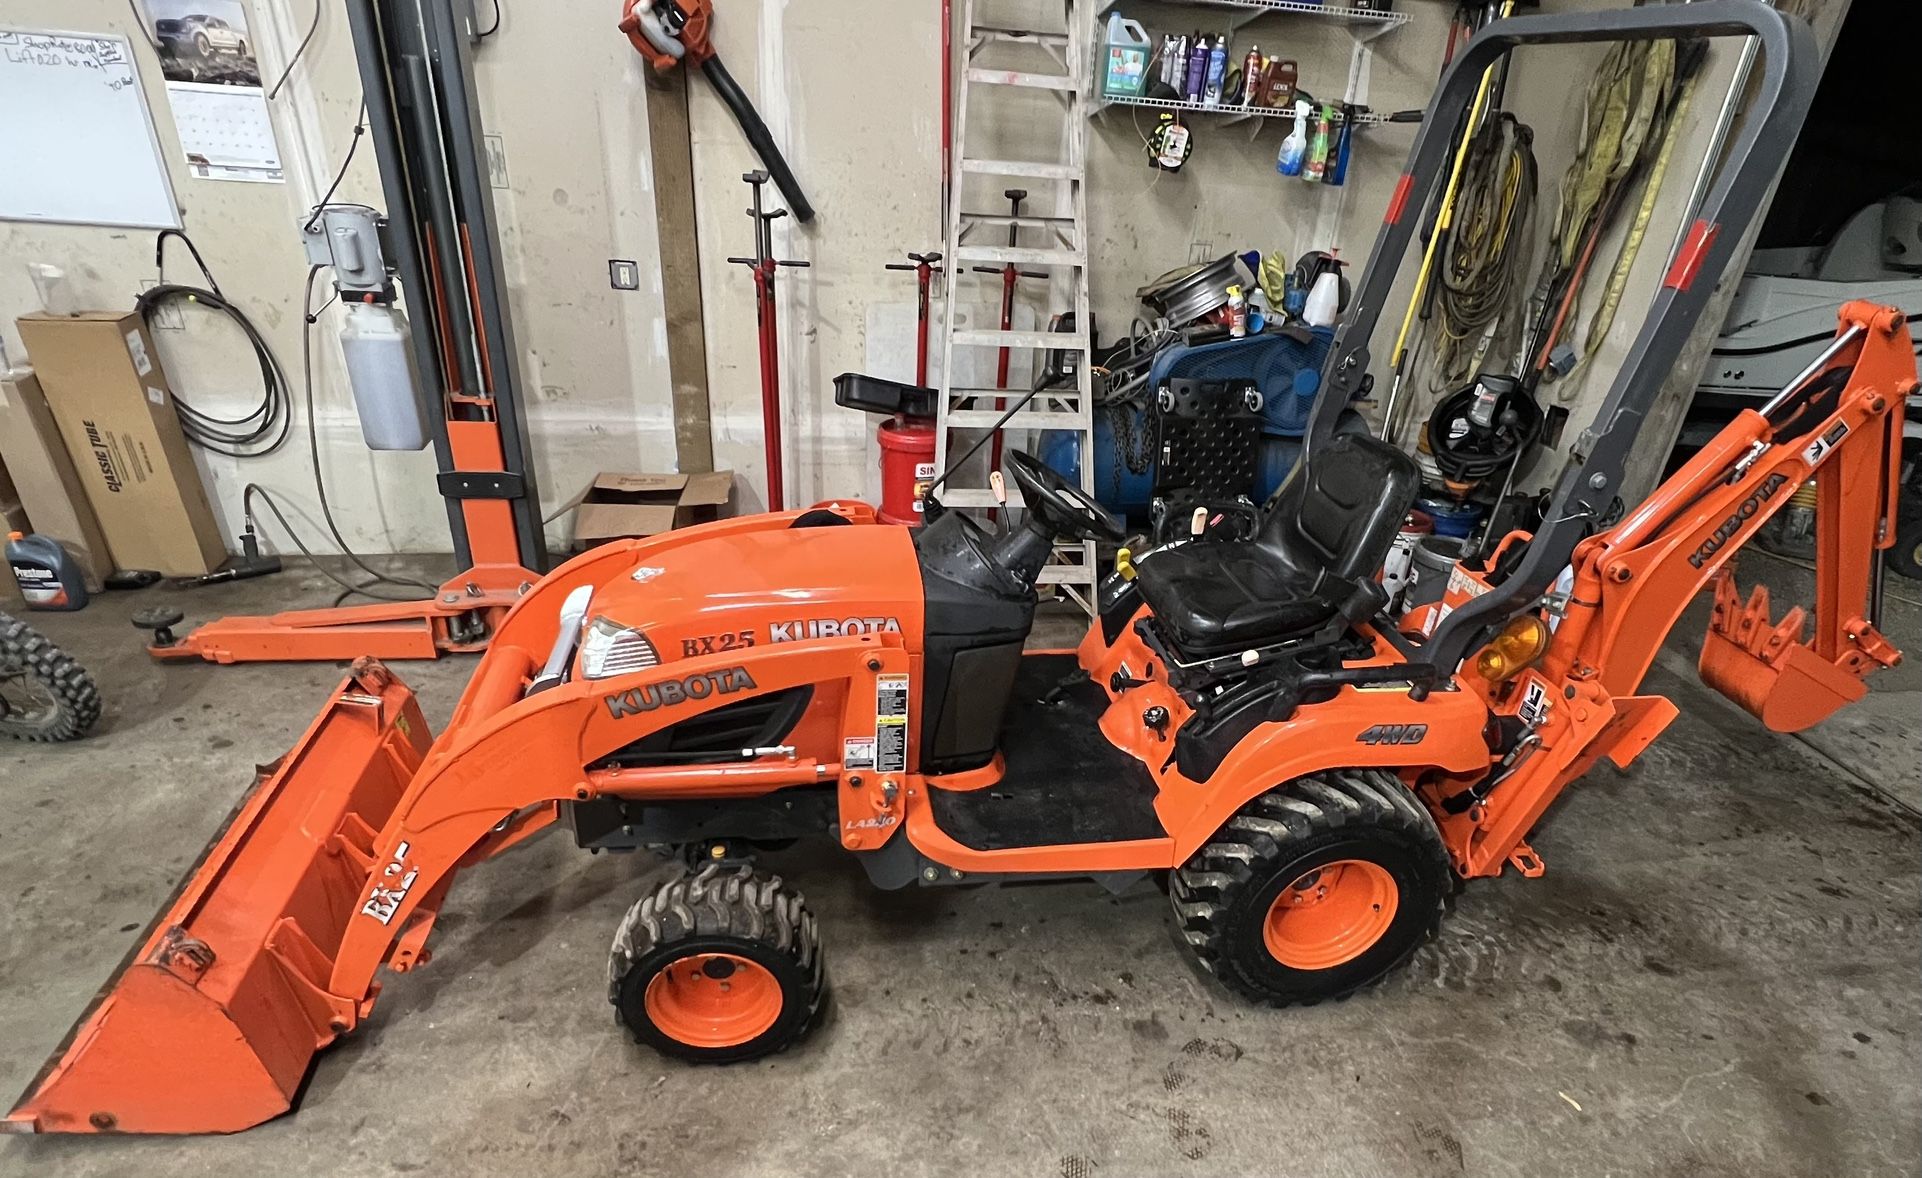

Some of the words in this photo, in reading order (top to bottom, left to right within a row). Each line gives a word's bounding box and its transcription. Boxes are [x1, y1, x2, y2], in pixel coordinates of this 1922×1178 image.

[82, 419, 108, 449] TUBE
[95, 450, 122, 493] CLASSIC
[1687, 472, 1789, 569] KUBOTA
[681, 630, 756, 658] BX25
[769, 617, 901, 644] KUBOTA
[605, 666, 758, 720] KUBOTA
[1356, 723, 1428, 745] 4WD
